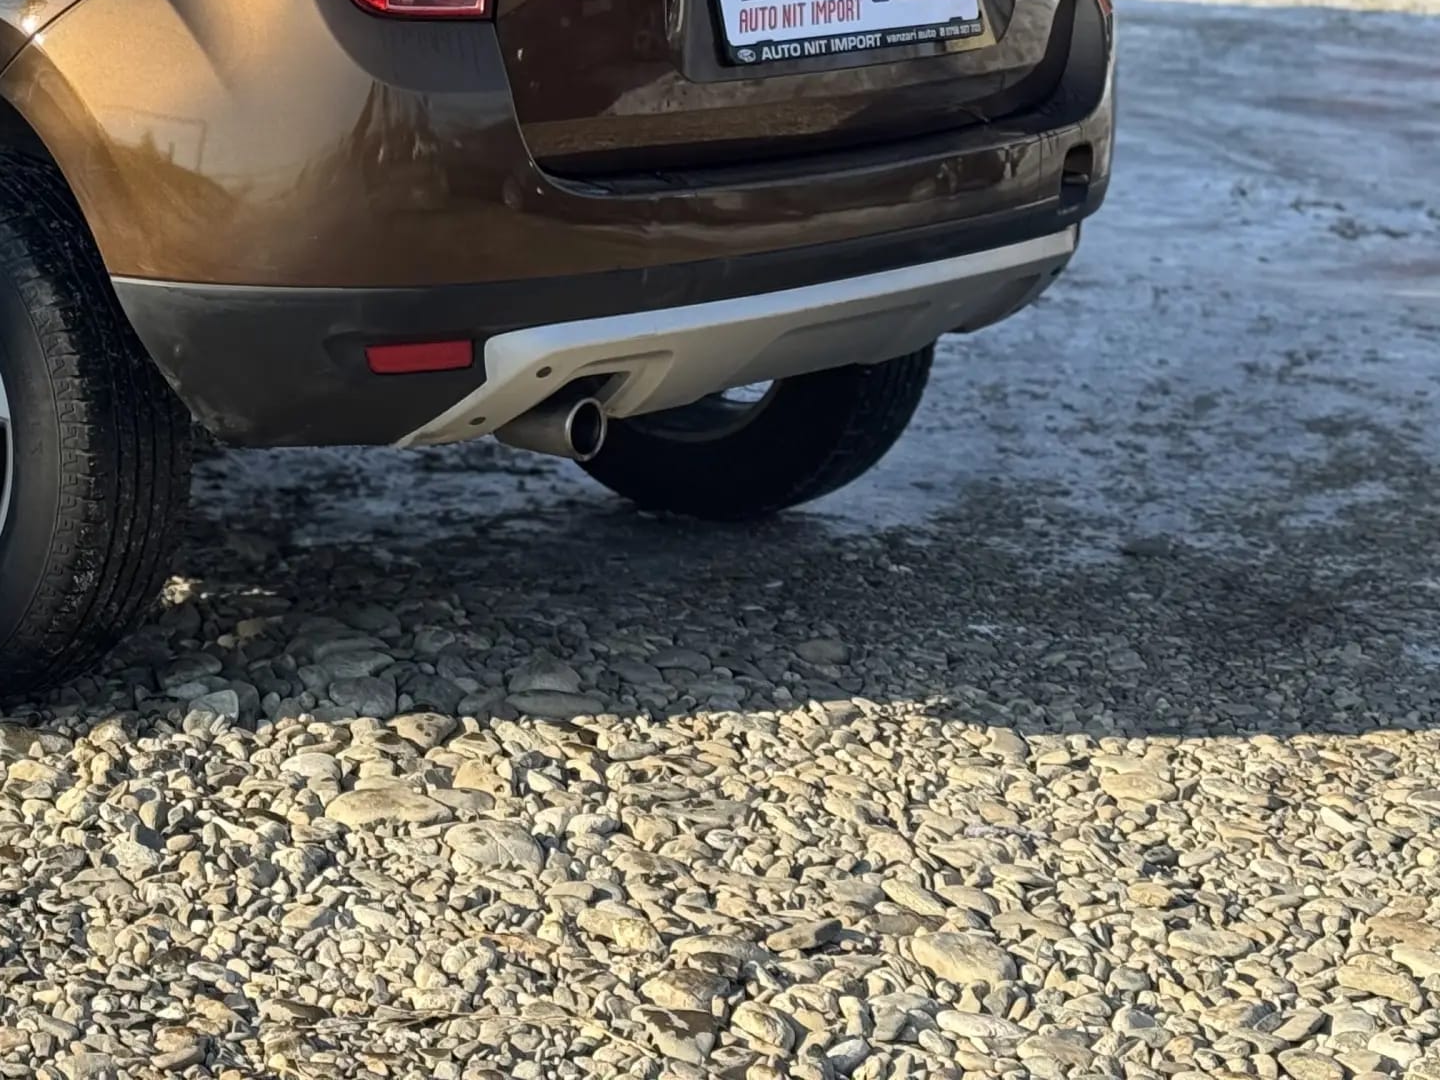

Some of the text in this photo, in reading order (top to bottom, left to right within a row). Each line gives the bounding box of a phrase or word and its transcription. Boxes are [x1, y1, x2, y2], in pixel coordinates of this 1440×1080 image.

[738, 5, 778, 34] AUTO
[782, 2, 807, 29] NIT
[761, 42, 801, 61] AUTO
[804, 38, 829, 56] NIT
[830, 33, 882, 53] IMPORT
